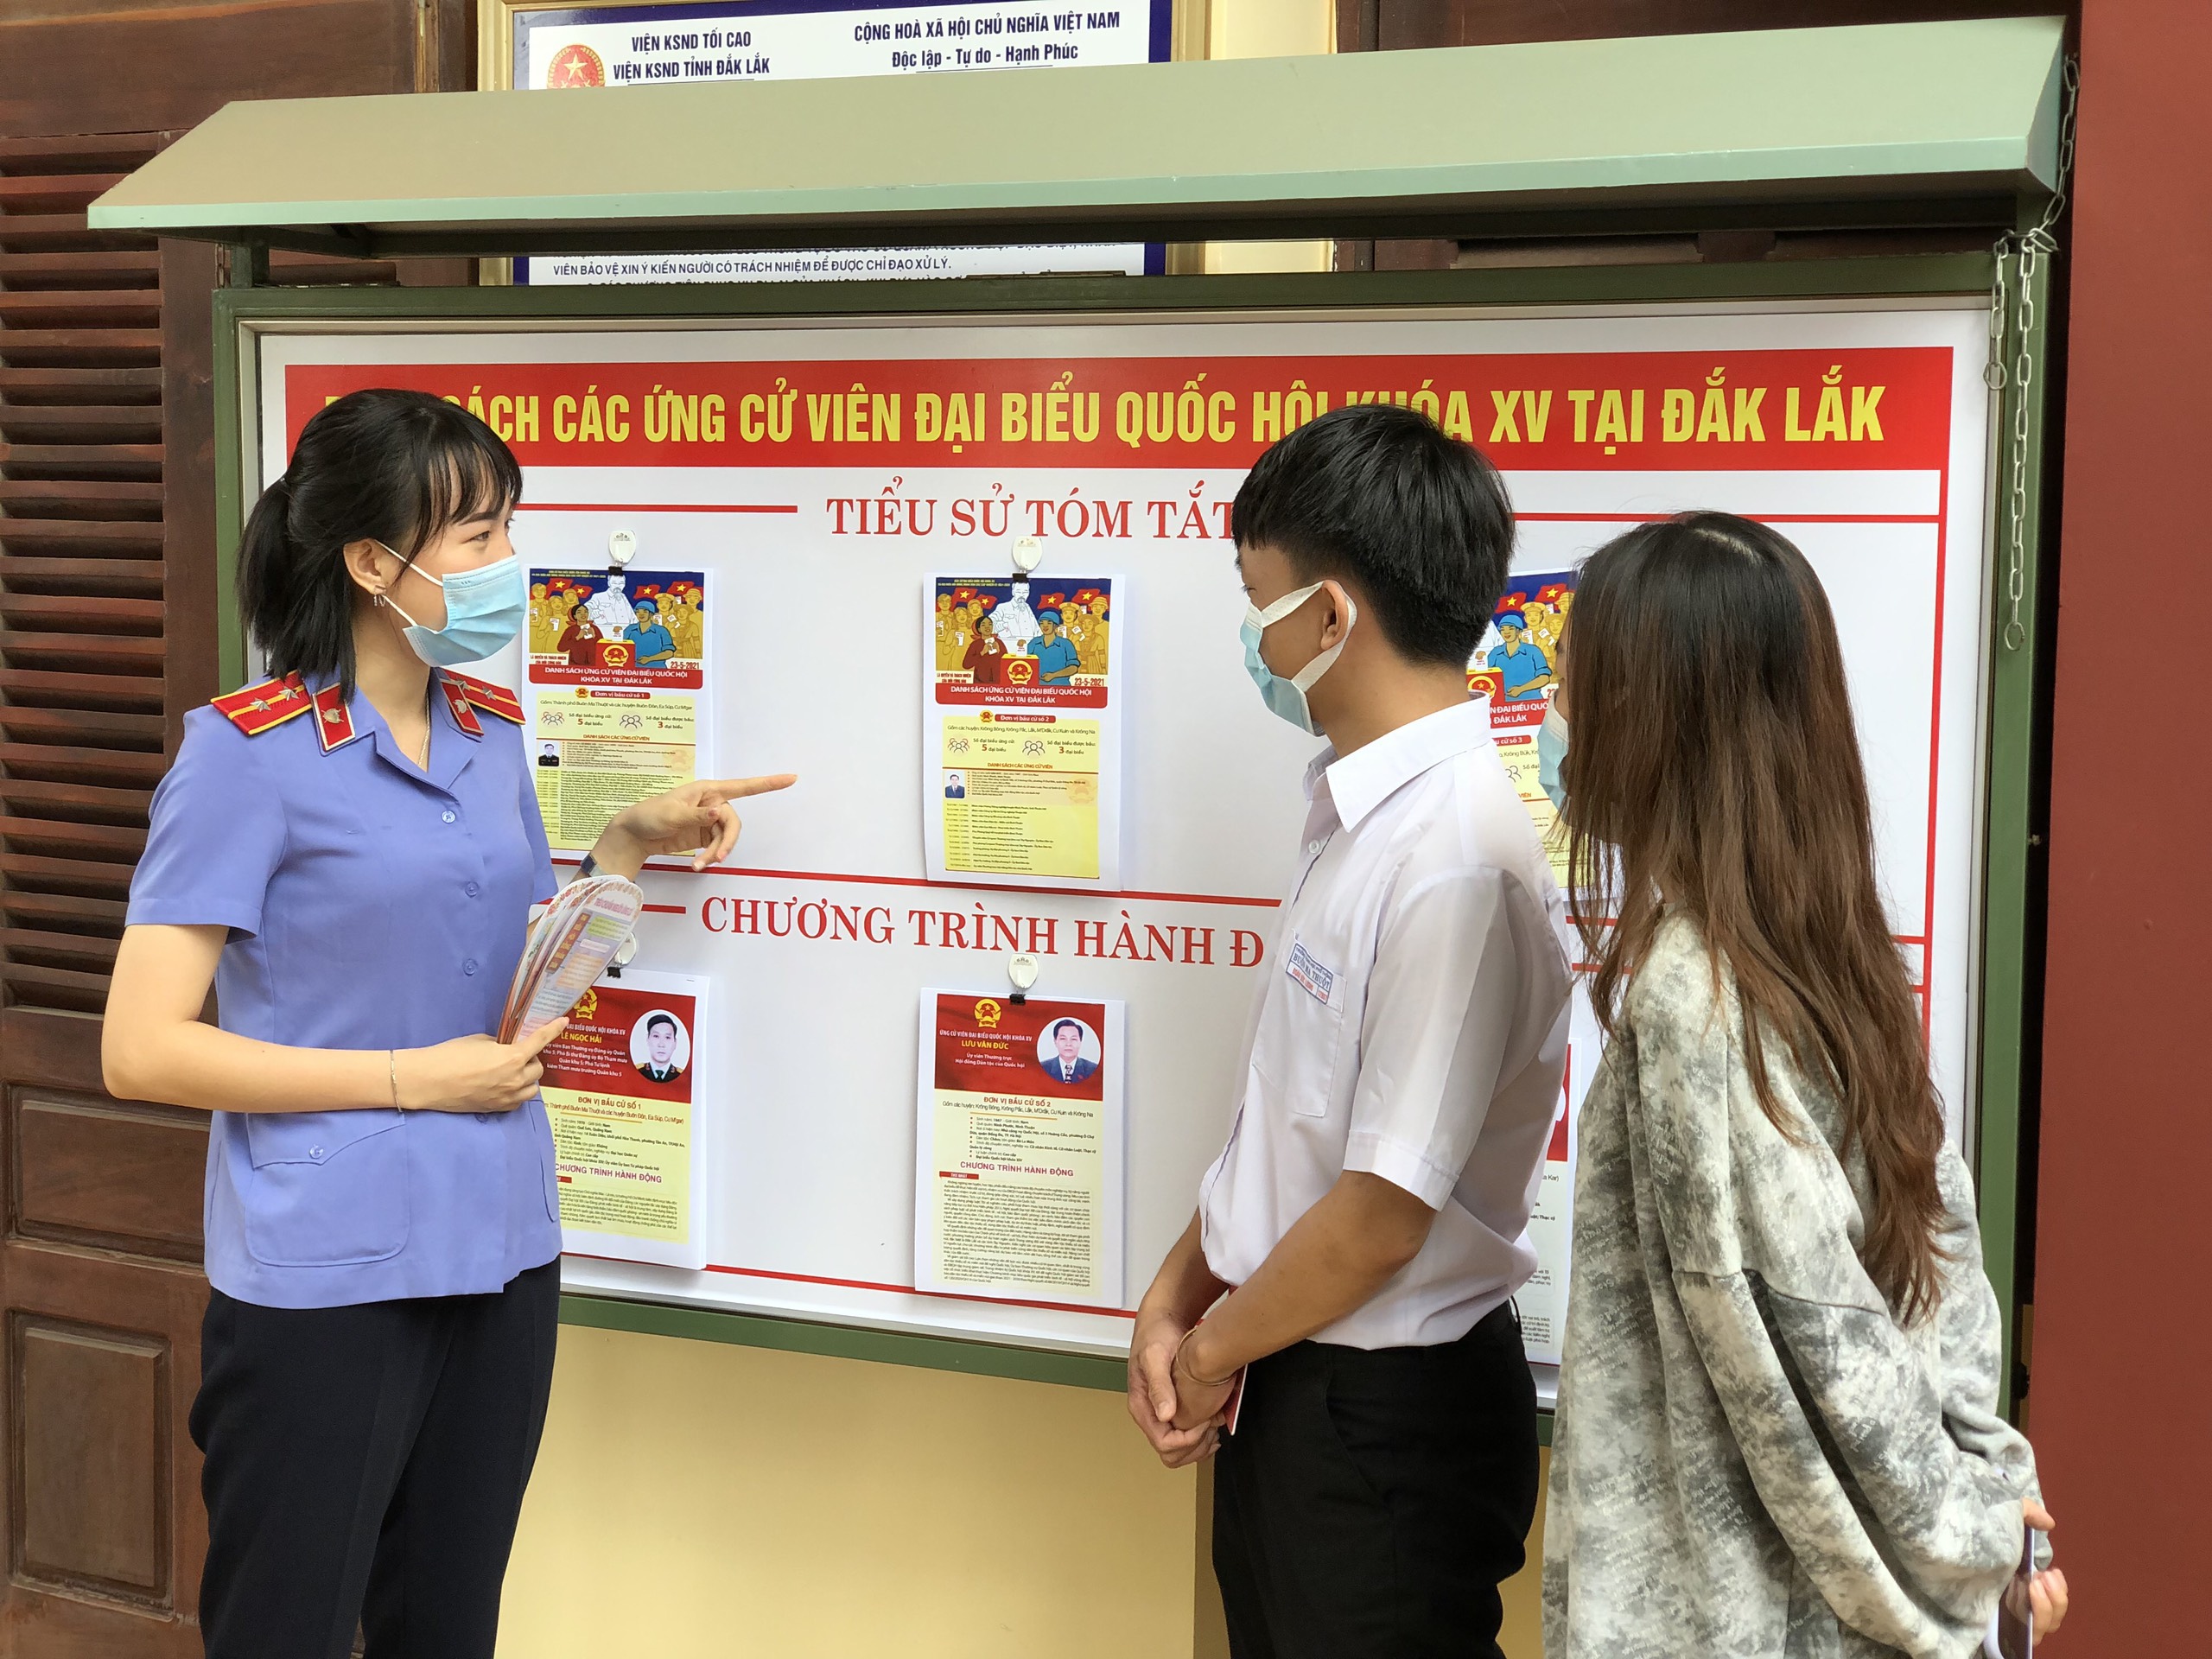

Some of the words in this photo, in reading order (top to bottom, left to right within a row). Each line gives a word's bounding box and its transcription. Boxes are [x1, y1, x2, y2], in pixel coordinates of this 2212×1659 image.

[855, 21, 890, 44] CỘNG
[895, 19, 921, 39] HOÀ
[926, 18, 944, 37] XÃ
[949, 16, 970, 40] HỘI
[976, 13, 1002, 35] CHỦ
[1007, 13, 1049, 34] NGHĨA
[1054, 10, 1083, 34] VIỆT
[1087, 11, 1120, 29] NAM
[632, 35, 660, 55] VIỆN
[664, 34, 698, 51] KSND
[703, 27, 721, 48] TỐI
[727, 31, 751, 48] CAO
[893, 51, 916, 70] Độc
[922, 49, 941, 69] lập
[956, 48, 971, 67] Tự
[976, 48, 991, 63] do
[1007, 45, 1039, 65] Hạnh
[1045, 42, 1077, 60] Phúc
[613, 61, 641, 83] VIỆN
[646, 61, 679, 78] KSND
[684, 55, 712, 76] TỈNH
[716, 54, 741, 75] ĐẮK
[747, 53, 770, 73] LẮK
[554, 263, 577, 275] VIÊN
[581, 262, 603, 275] BẢO
[606, 262, 619, 276] VỆ
[621, 264, 639, 275] XIN
[641, 261, 648, 274] Ý
[652, 259, 676, 274] KIẾN
[679, 261, 713, 274] NGƯỜI
[716, 260, 732, 273] CÓ
[734, 259, 772, 273] TRÁCH
[775, 259, 810, 274] NHIỆM
[814, 256, 829, 271] ĐỂ
[832, 258, 863, 272] ĐƯỢC
[867, 256, 886, 270] CHỈ
[889, 258, 913, 271] ĐẠO
[916, 255, 932, 270] XỬ
[934, 256, 951, 270] LÝ.
[442, 385, 539, 442] ÁCH
[553, 385, 628, 442] CÁC
[644, 384, 726, 442] ỨNG
[740, 377, 798, 442] CỬ
[807, 383, 900, 442] VIÊN
[915, 392, 986, 453] ĐẠI
[1001, 372, 1100, 442] BIỂU
[1116, 372, 1236, 448] QUỐC
[1491, 390, 1553, 442] XV
[1567, 390, 1644, 454] TẠI
[1662, 366, 1767, 442] ĐẮK
[1784, 365, 1885, 442] LẮK
[826, 475, 937, 536] TIỂU
[951, 482, 1014, 537] SỬ
[1026, 487, 1133, 537] TÓM
[1147, 480, 1235, 538] TẮT
[655, 669, 675, 677] QUỐC
[676, 670, 687, 678] HỘI
[1058, 688, 1078, 696] QUỐC
[702, 896, 894, 944] CHƯƠNG
[908, 902, 1058, 955] TRÌNH
[1075, 910, 1215, 965] HÀNH
[570, 1033, 588, 1043] NGỌC
[589, 1033, 601, 1043] HẢI
[601, 1097, 614, 1107] BẦU
[616, 1098, 626, 1108] CỬ
[627, 1101, 637, 1109] SỐ
[1008, 1097, 1022, 1106] BẦU
[589, 1166, 613, 1178] TRÌNH
[615, 1167, 637, 1180] HÀNH
[639, 1171, 662, 1183] ĐỘNG
[961, 1161, 995, 1171] CHƯƠNG
[997, 1163, 1022, 1173] TRÌNH
[1025, 1165, 1046, 1175] HÀNH
[1050, 1166, 1073, 1177] ĐỘNG
